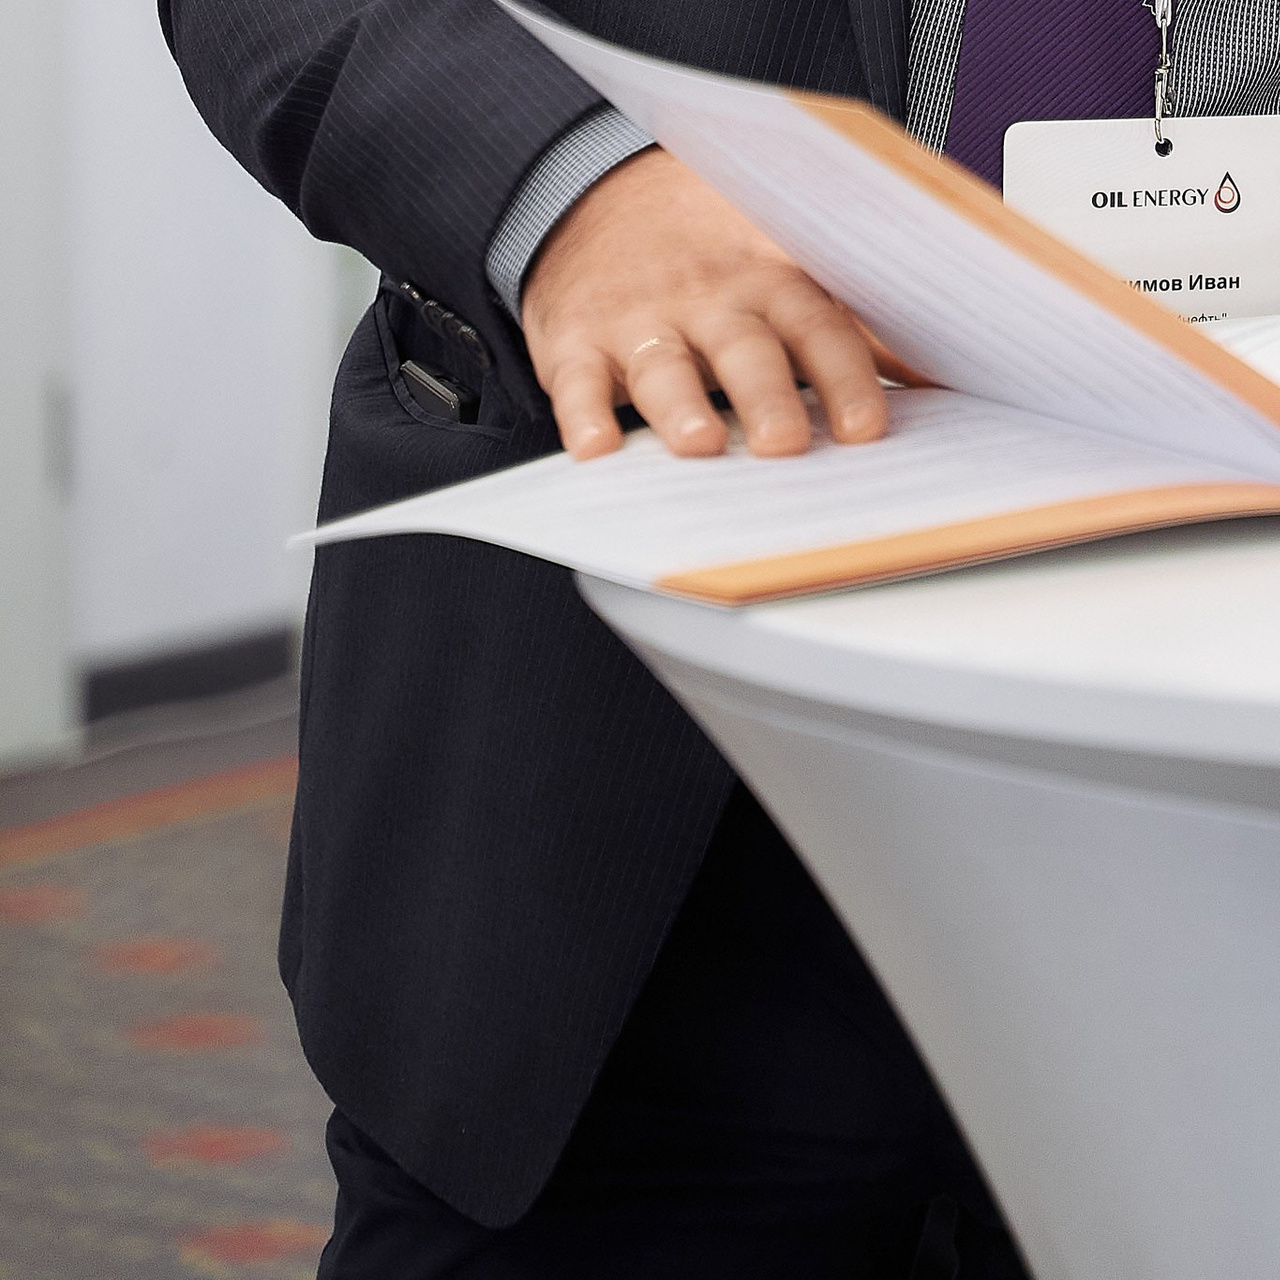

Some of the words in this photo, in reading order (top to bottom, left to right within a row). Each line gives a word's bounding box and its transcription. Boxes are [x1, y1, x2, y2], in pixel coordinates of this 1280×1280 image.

[1092, 191, 1127, 208] OIL
[1133, 188, 1209, 207] ENERGY
[1189, 274, 1240, 290] Иван
